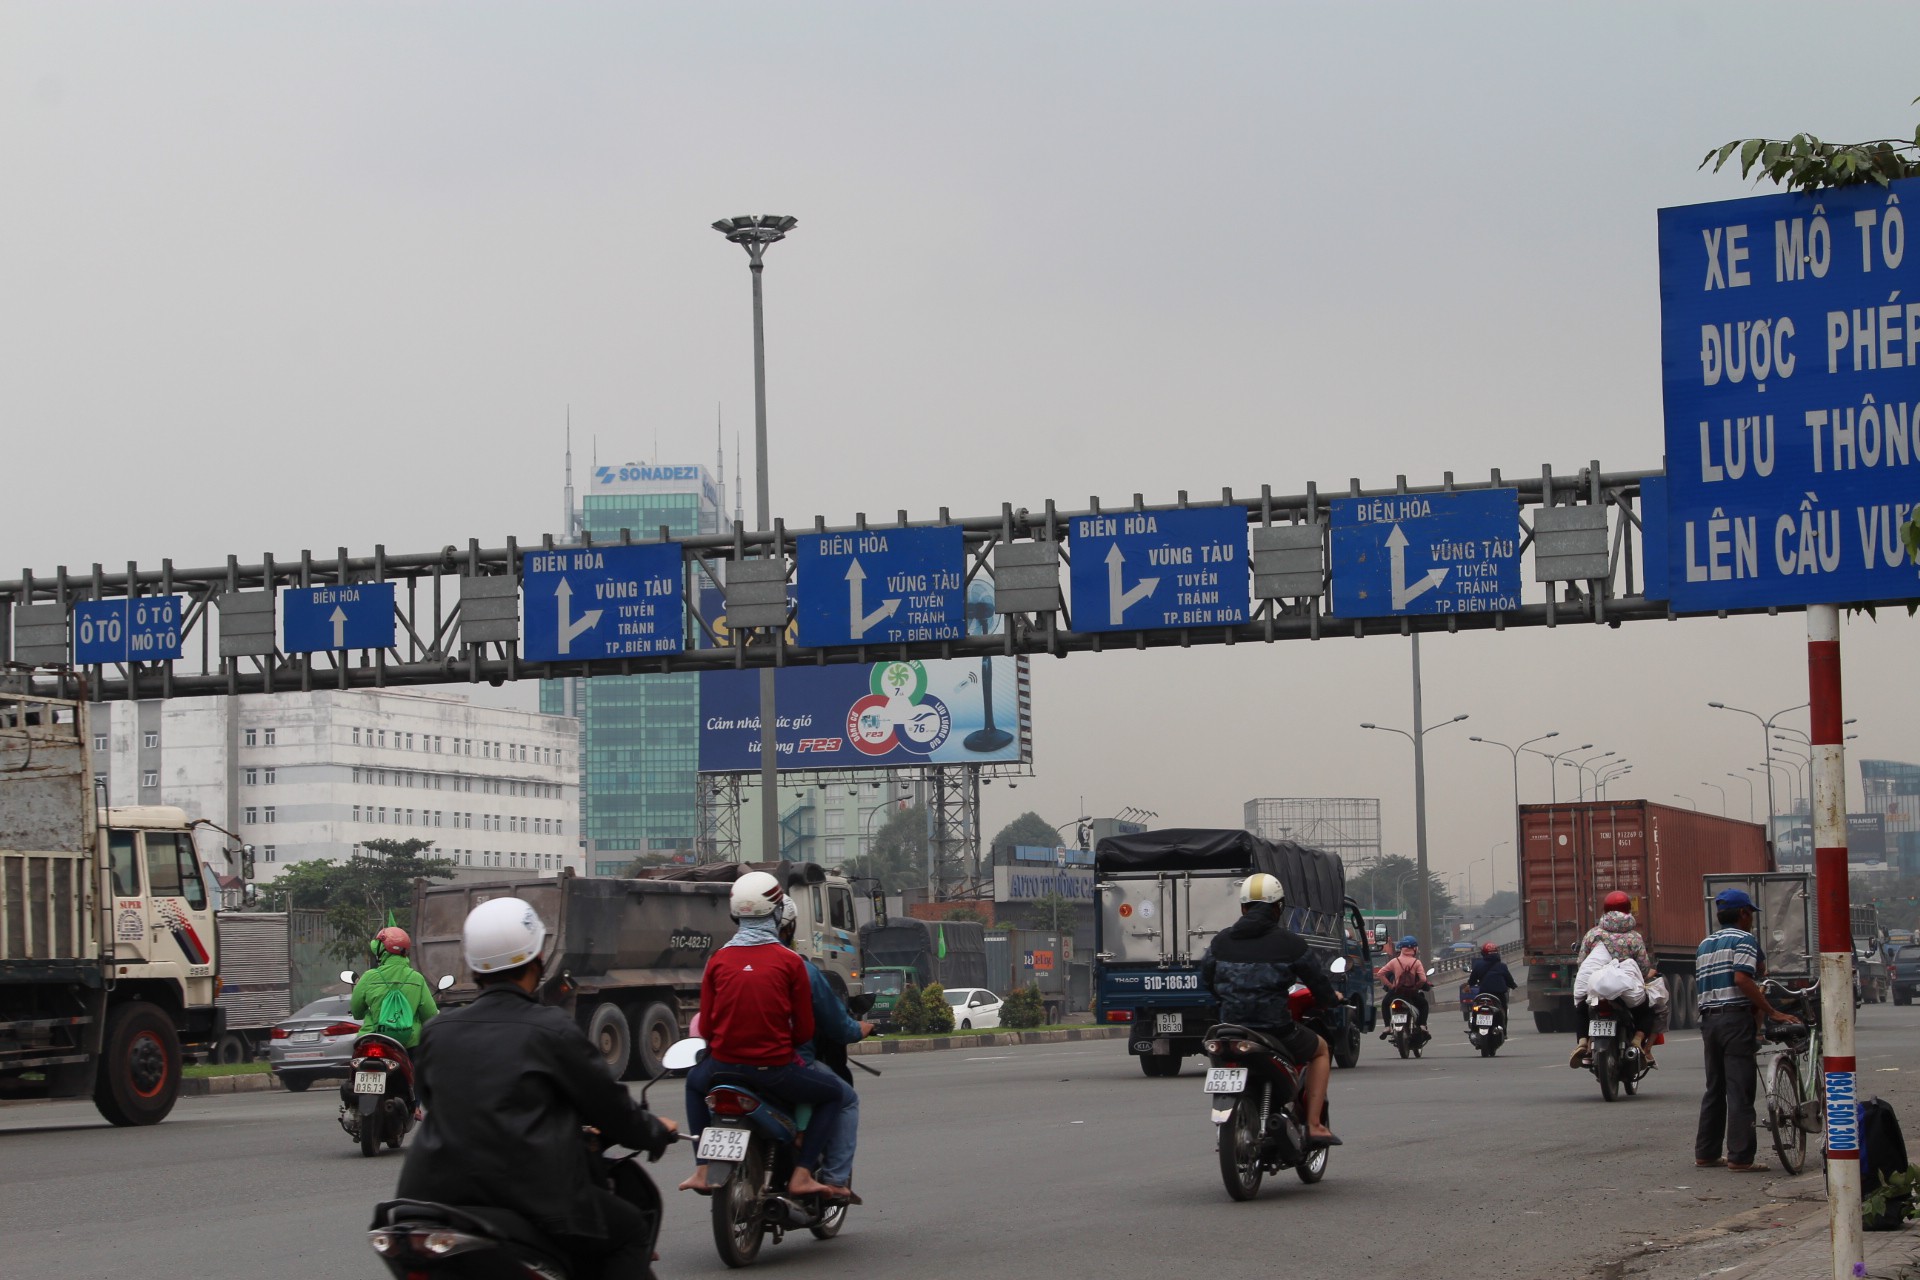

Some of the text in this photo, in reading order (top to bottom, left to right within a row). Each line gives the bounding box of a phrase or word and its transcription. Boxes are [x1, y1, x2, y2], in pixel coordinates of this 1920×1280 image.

[1702, 193, 1905, 291] XE MÔ TÔ
[1700, 316, 1796, 392] ĐƯỢC
[1699, 414, 1775, 483] LƯU
[619, 466, 698, 481] SONADEZI
[1357, 497, 1431, 522] BIÊN HÒA
[1079, 513, 1158, 538] BIÊN HÒA
[820, 532, 888, 556] BIÊN HÒA
[1685, 491, 1920, 583] LÊN CẦU VƯ
[1149, 539, 1234, 566] VŨNG TÀU
[1431, 536, 1513, 562] VŨNG TÀU
[532, 550, 604, 573] BIÊN HÒA
[1456, 559, 1498, 577] TUYẾN
[887, 569, 960, 593] VŨNG TÀU
[1177, 568, 1218, 587] TUYẾN
[1456, 578, 1498, 595] TRÁNH
[313, 586, 360, 604] BIÊN HÒA
[595, 574, 672, 600] VŨNG TÀU
[1177, 589, 1219, 606] TRÁNH
[1436, 594, 1516, 613] TP. BIÊN HÒA
[136, 601, 173, 625] Ô TÔ
[907, 609, 945, 625] TRÁNH
[1183, 608, 1212, 624] BIÊN
[1217, 605, 1242, 622] HÒA
[618, 620, 655, 636] TRÁNH
[908, 626, 932, 641] BIÊN
[935, 623, 959, 639] HÒA
[131, 627, 176, 651] MÔ TÔ
[655, 636, 676, 651] HÒA
[707, 714, 812, 731] Cảm nhậ ức gió
[913, 724, 925, 733] 76
[798, 738, 842, 753] F23
[1010, 874, 1039, 897] AUTO
[120, 901, 142, 909] SUPER
[670, 935, 712, 950] 51C-482.51
[1144, 975, 1198, 990] 51D-186.30
[1159, 1023, 1182, 1032] 186.30
[1162, 1014, 1177, 1023] 51D
[359, 1073, 381, 1083] 81-H1
[1213, 1070, 1240, 1080] 60-F1
[355, 1083, 384, 1094] 036.73
[1206, 1080, 1243, 1092] 058.13
[709, 1130, 742, 1145] 35-B2
[701, 1143, 743, 1159] 032.23
